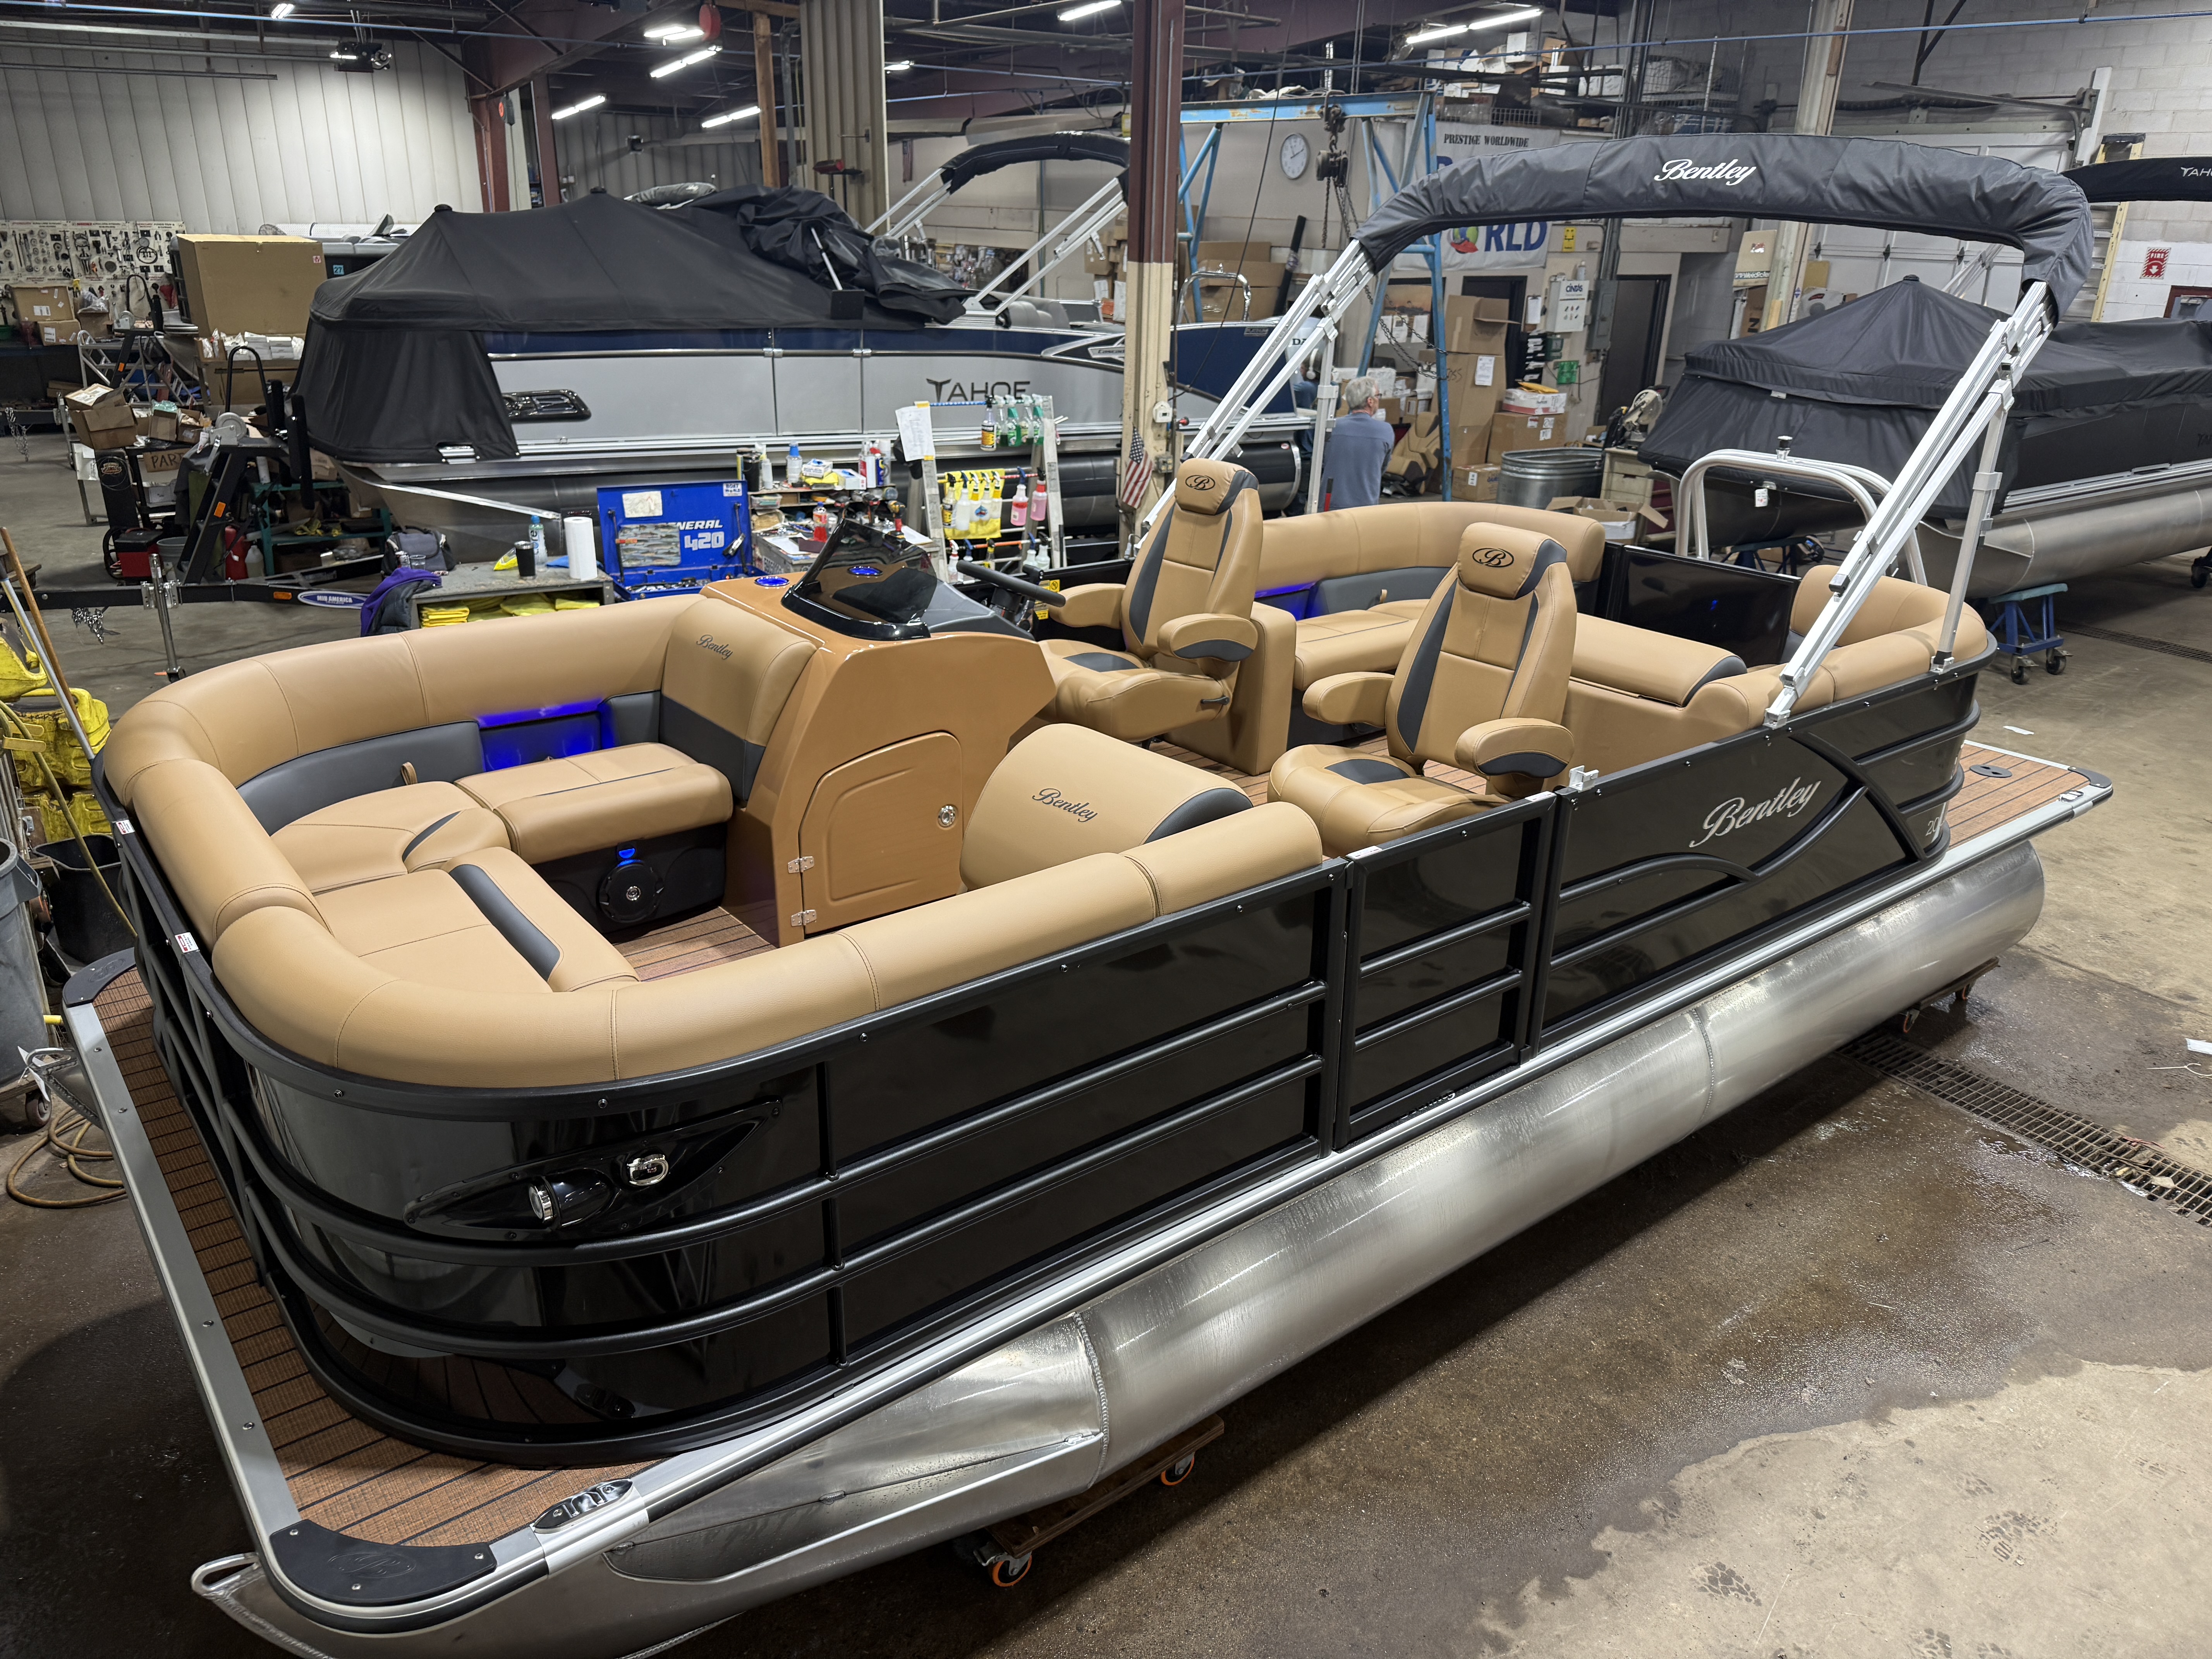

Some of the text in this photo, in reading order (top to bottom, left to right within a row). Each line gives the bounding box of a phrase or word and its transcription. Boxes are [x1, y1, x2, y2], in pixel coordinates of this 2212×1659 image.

[1444, 134, 1529, 147] PRESTIGE WORLDWIDE
[1654, 159, 1756, 185] Bentley
[926, 378, 1030, 402] TAHOE
[658, 520, 723, 530] NERAL
[684, 531, 724, 550] 420
[696, 634, 733, 660] Bentley
[1032, 788, 1098, 822] Bentley
[1689, 776, 1821, 848] Bentley
